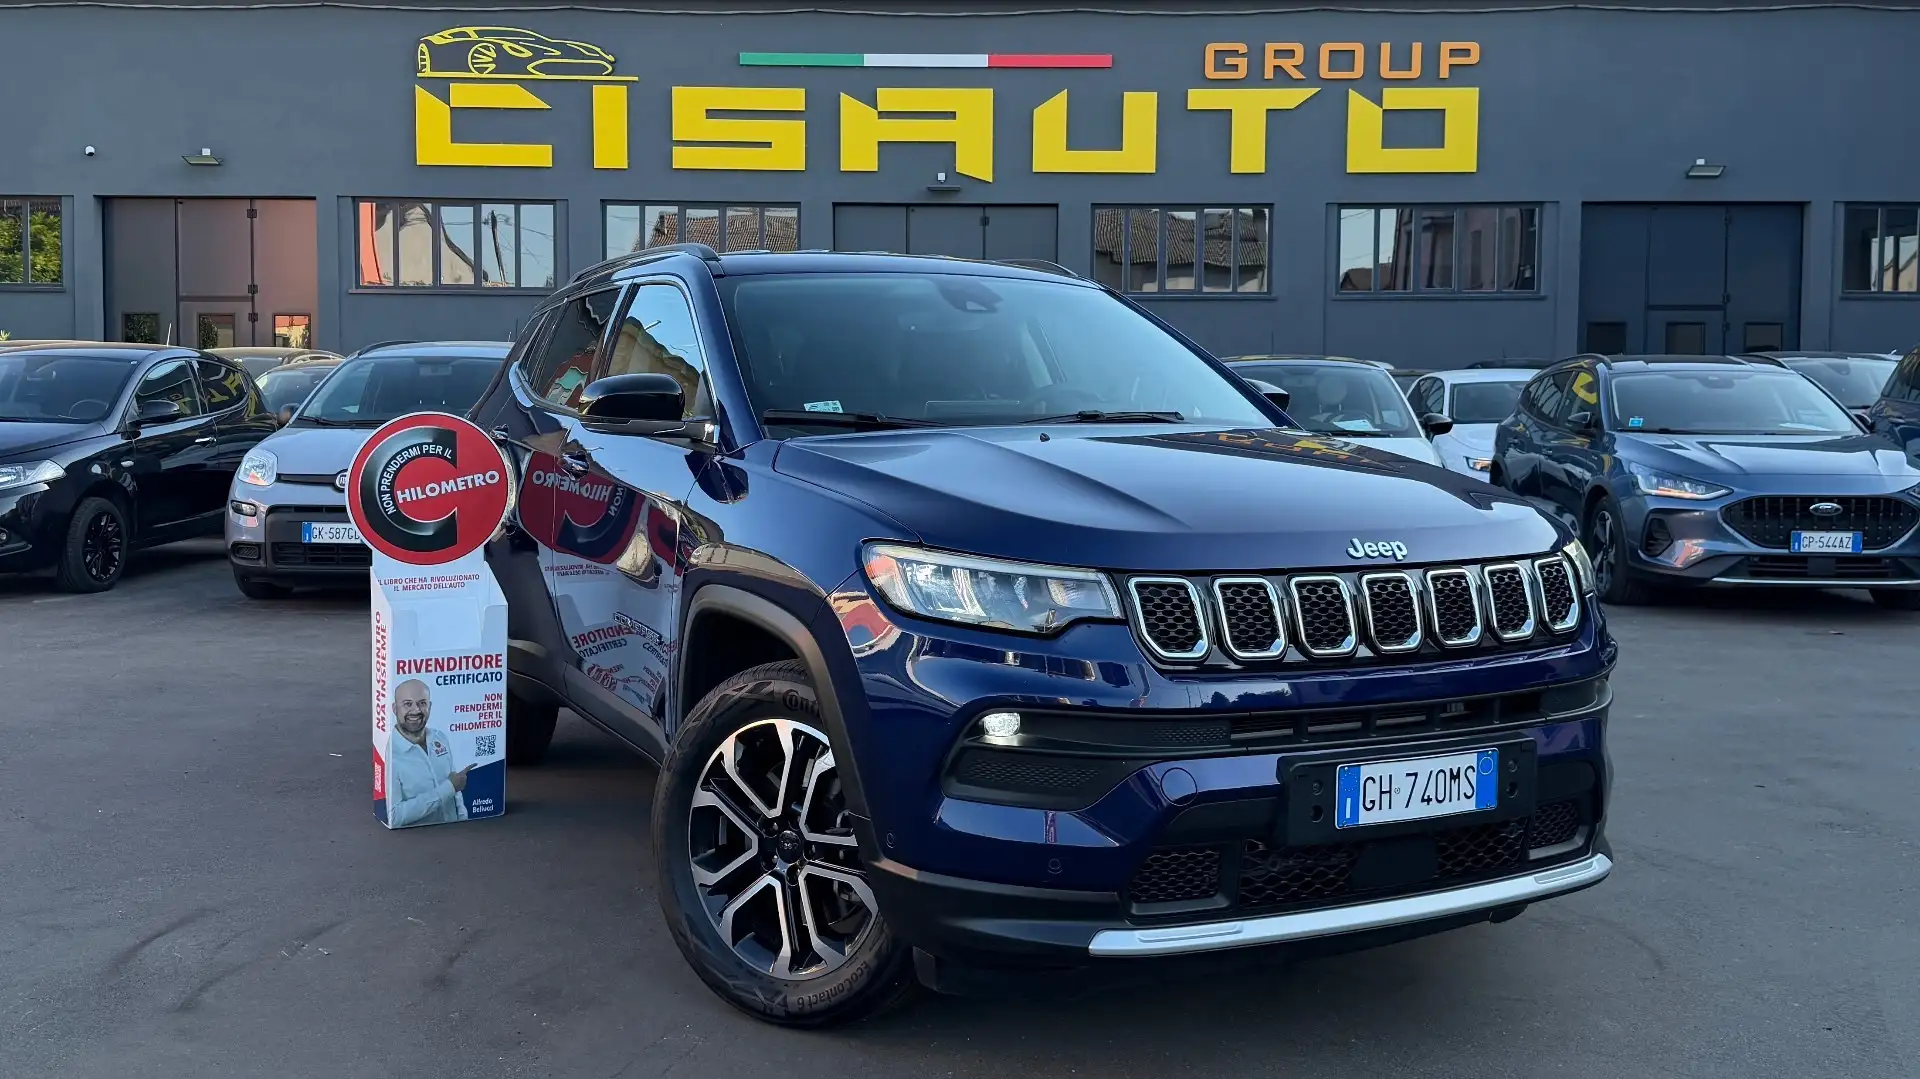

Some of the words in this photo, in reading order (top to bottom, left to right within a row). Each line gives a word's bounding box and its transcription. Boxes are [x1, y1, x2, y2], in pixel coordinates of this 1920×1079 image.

[1204, 42, 1480, 80] GROUP
[415, 83, 1480, 183] CISAUTO
[422, 444, 442, 455] PER
[444, 449, 453, 459] IL
[380, 445, 421, 491] PRENDERMI
[396, 470, 500, 504] HILOMETRO
[380, 493, 396, 515] NON
[1347, 538, 1408, 560] Jeep
[430, 574, 480, 583] RIVOLUZIONATO
[434, 582, 465, 590] DELL'AUTO
[396, 654, 503, 675] RIVENDITORE
[436, 671, 503, 686] CERTIFICATO
[484, 693, 503, 701] NON
[454, 702, 503, 713] PRENDERMI
[479, 712, 494, 720] PER
[450, 720, 502, 732] CHILOMETRO
[473, 805, 494, 813] Bellucci
[808, 960, 871, 1009] EcoContact
[797, 996, 805, 1008] 6
